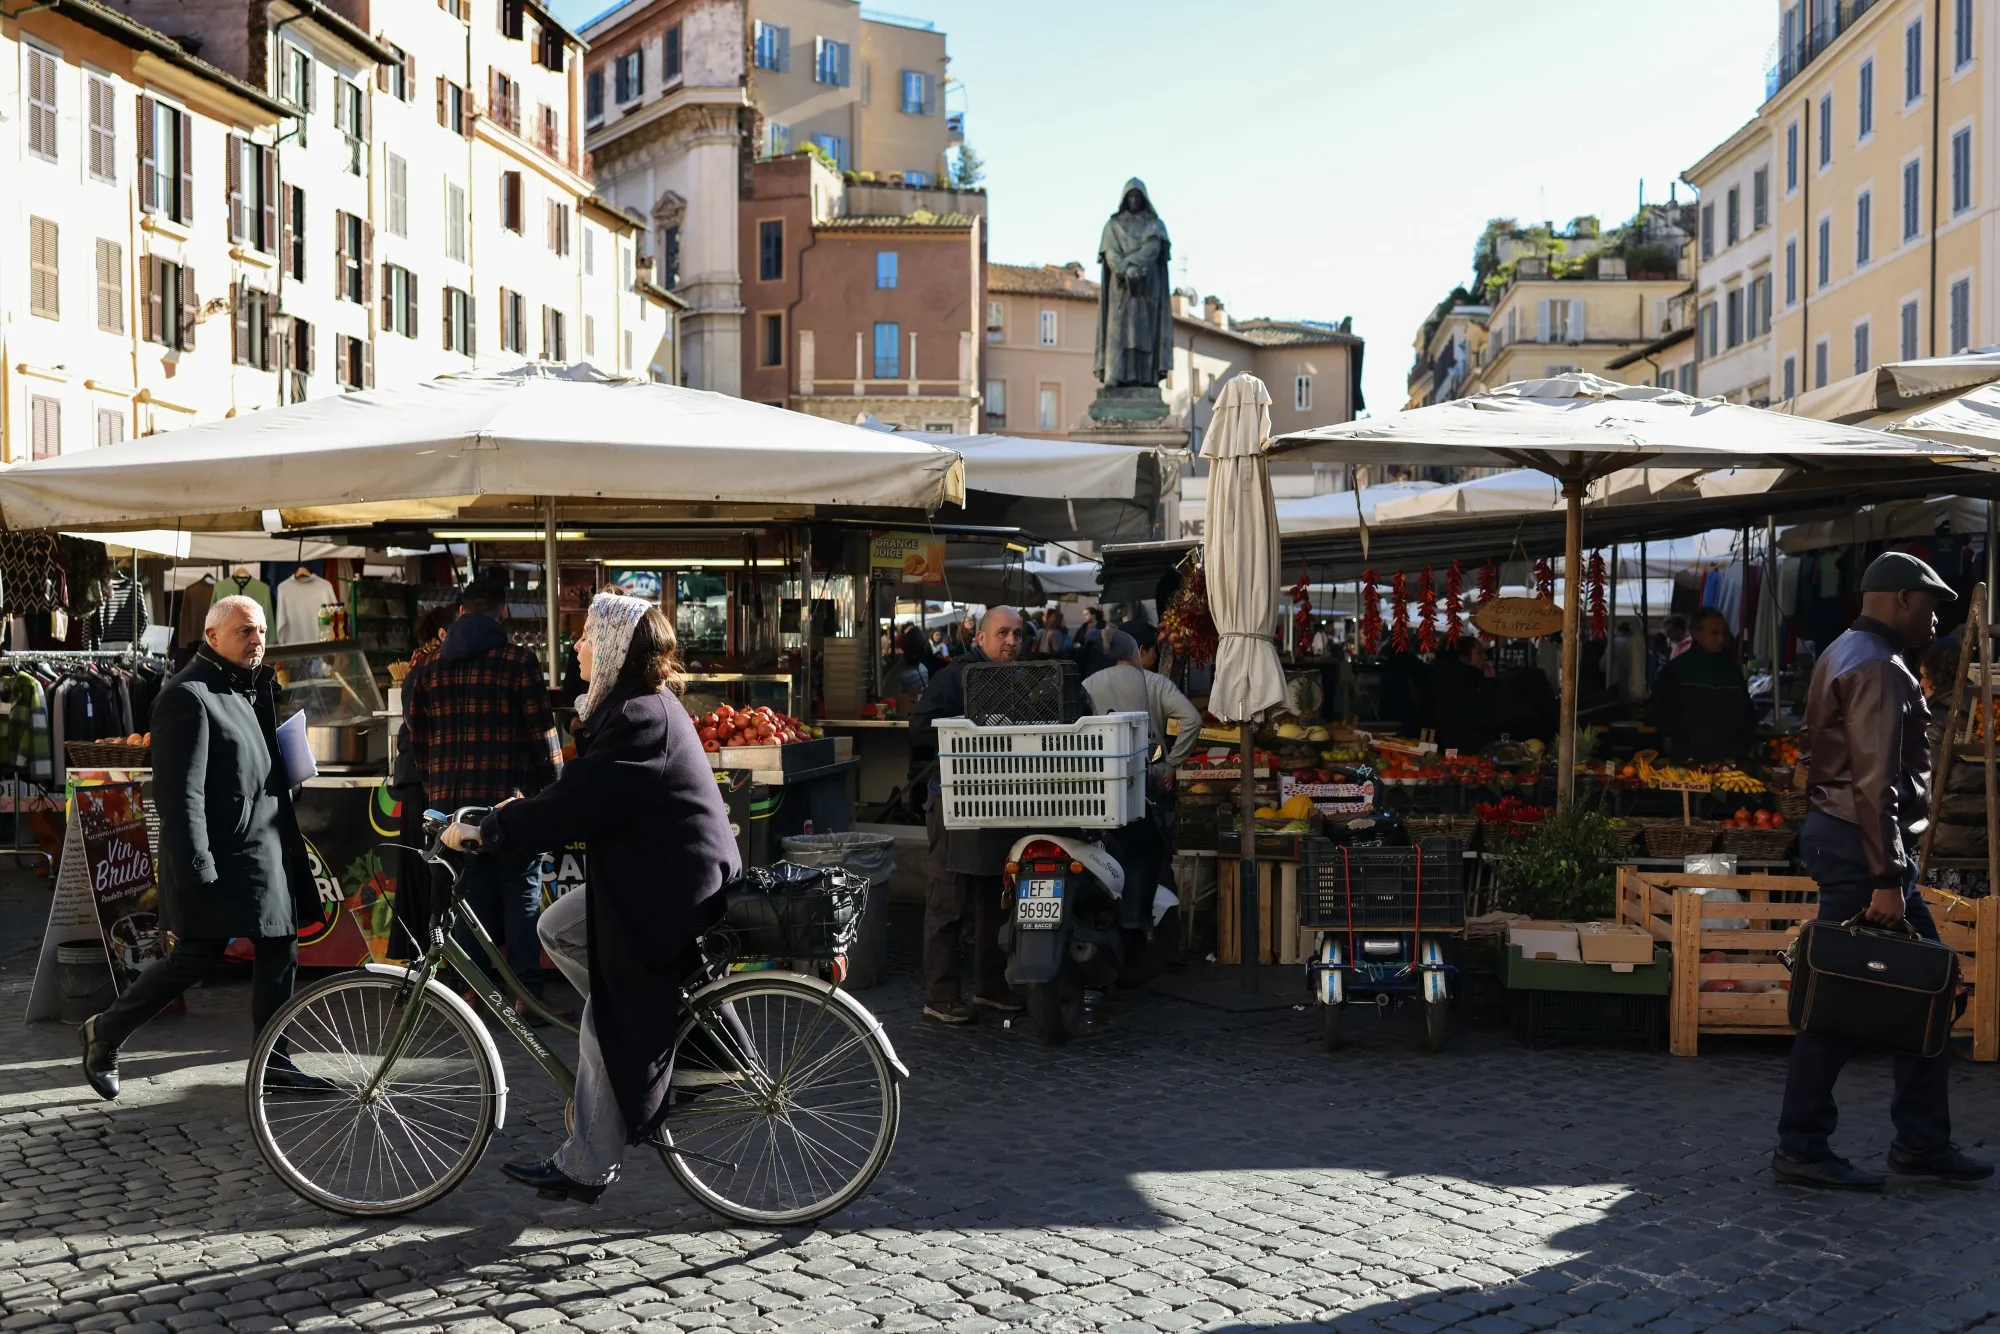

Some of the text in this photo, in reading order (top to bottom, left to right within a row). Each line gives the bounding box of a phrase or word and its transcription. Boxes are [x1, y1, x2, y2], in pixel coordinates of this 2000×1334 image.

[875, 538, 919, 549] ORANGE
[874, 548, 903, 558] JUICE
[1491, 620, 1541, 630] TRUFFLE
[108, 838, 134, 863] Vin
[96, 851, 151, 891] Brulè
[1029, 880, 1047, 897] EF
[101, 891, 124, 904] Prodotto
[1020, 902, 1060, 919] 96992
[488, 990, 503, 1007] Di
